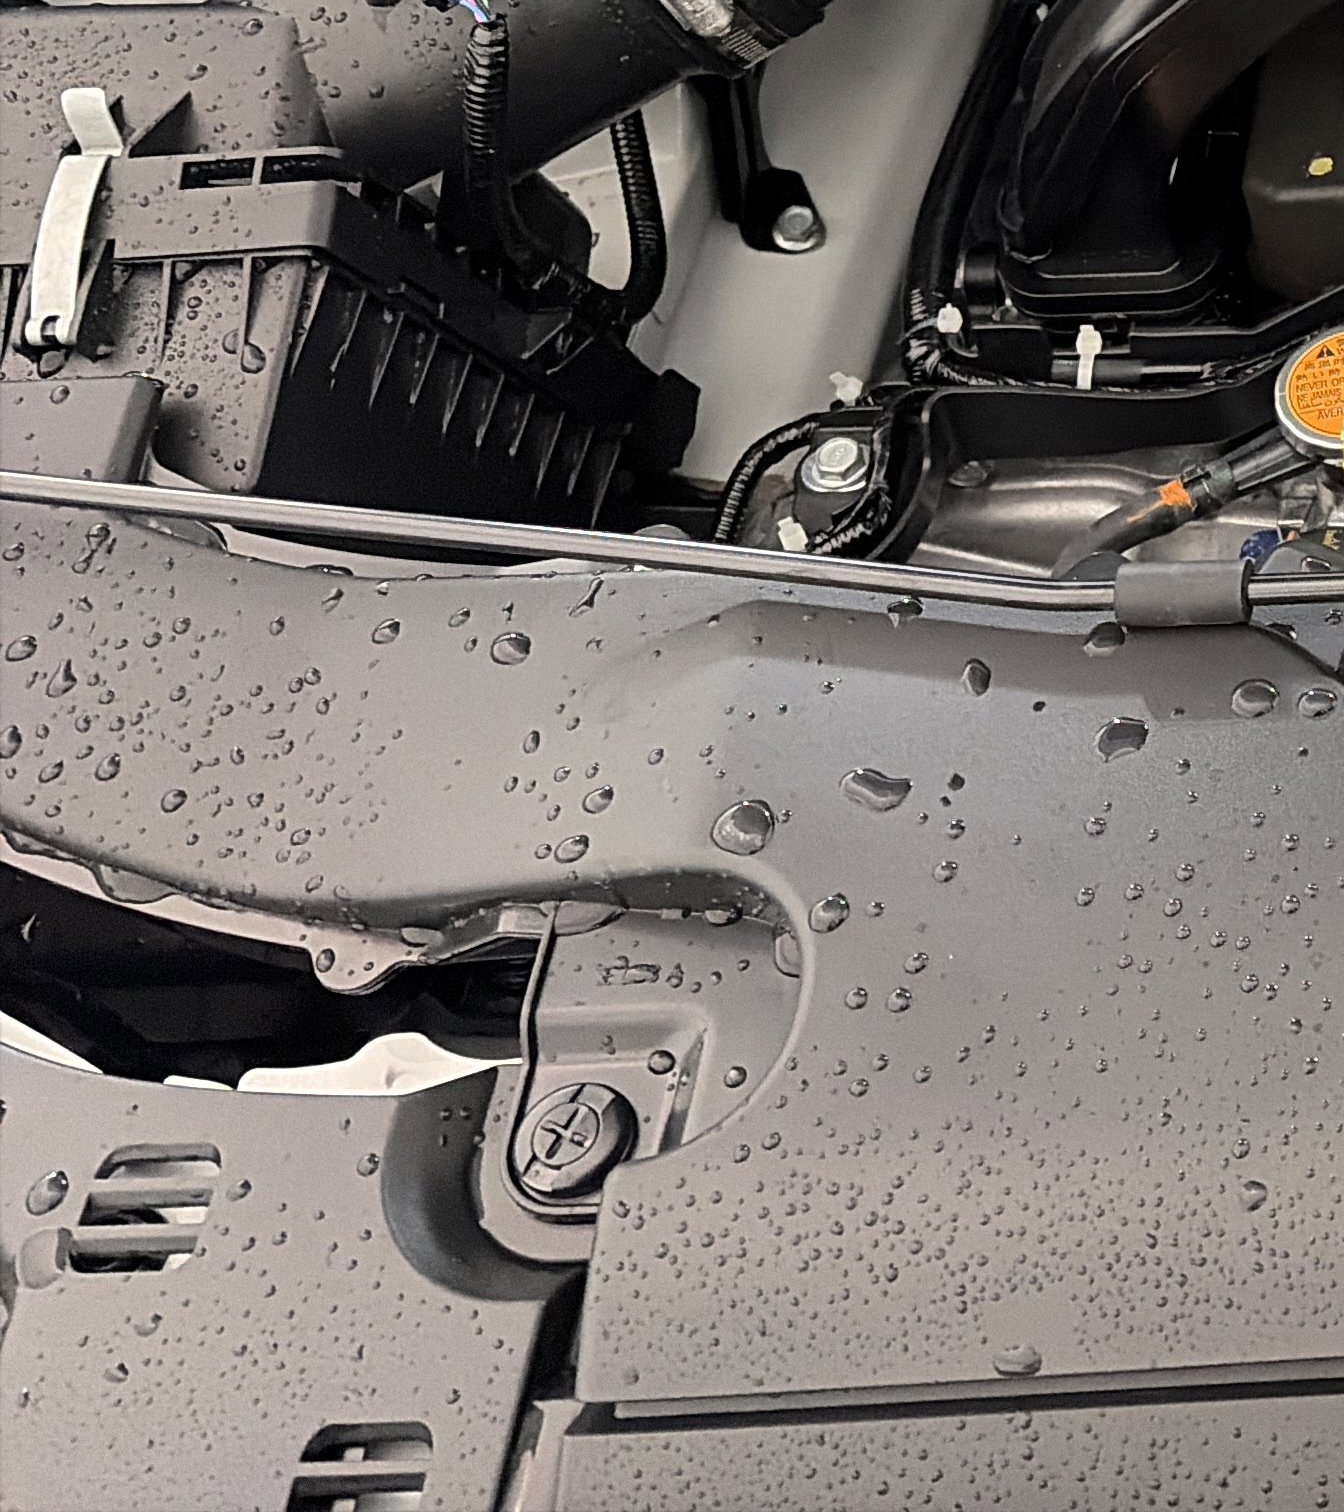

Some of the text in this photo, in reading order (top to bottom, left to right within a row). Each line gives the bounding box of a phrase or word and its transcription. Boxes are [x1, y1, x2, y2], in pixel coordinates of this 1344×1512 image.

[1295, 380, 1328, 393] NEVER
[1296, 393, 1308, 403] NE
[1312, 388, 1342, 401] JAMAIS
